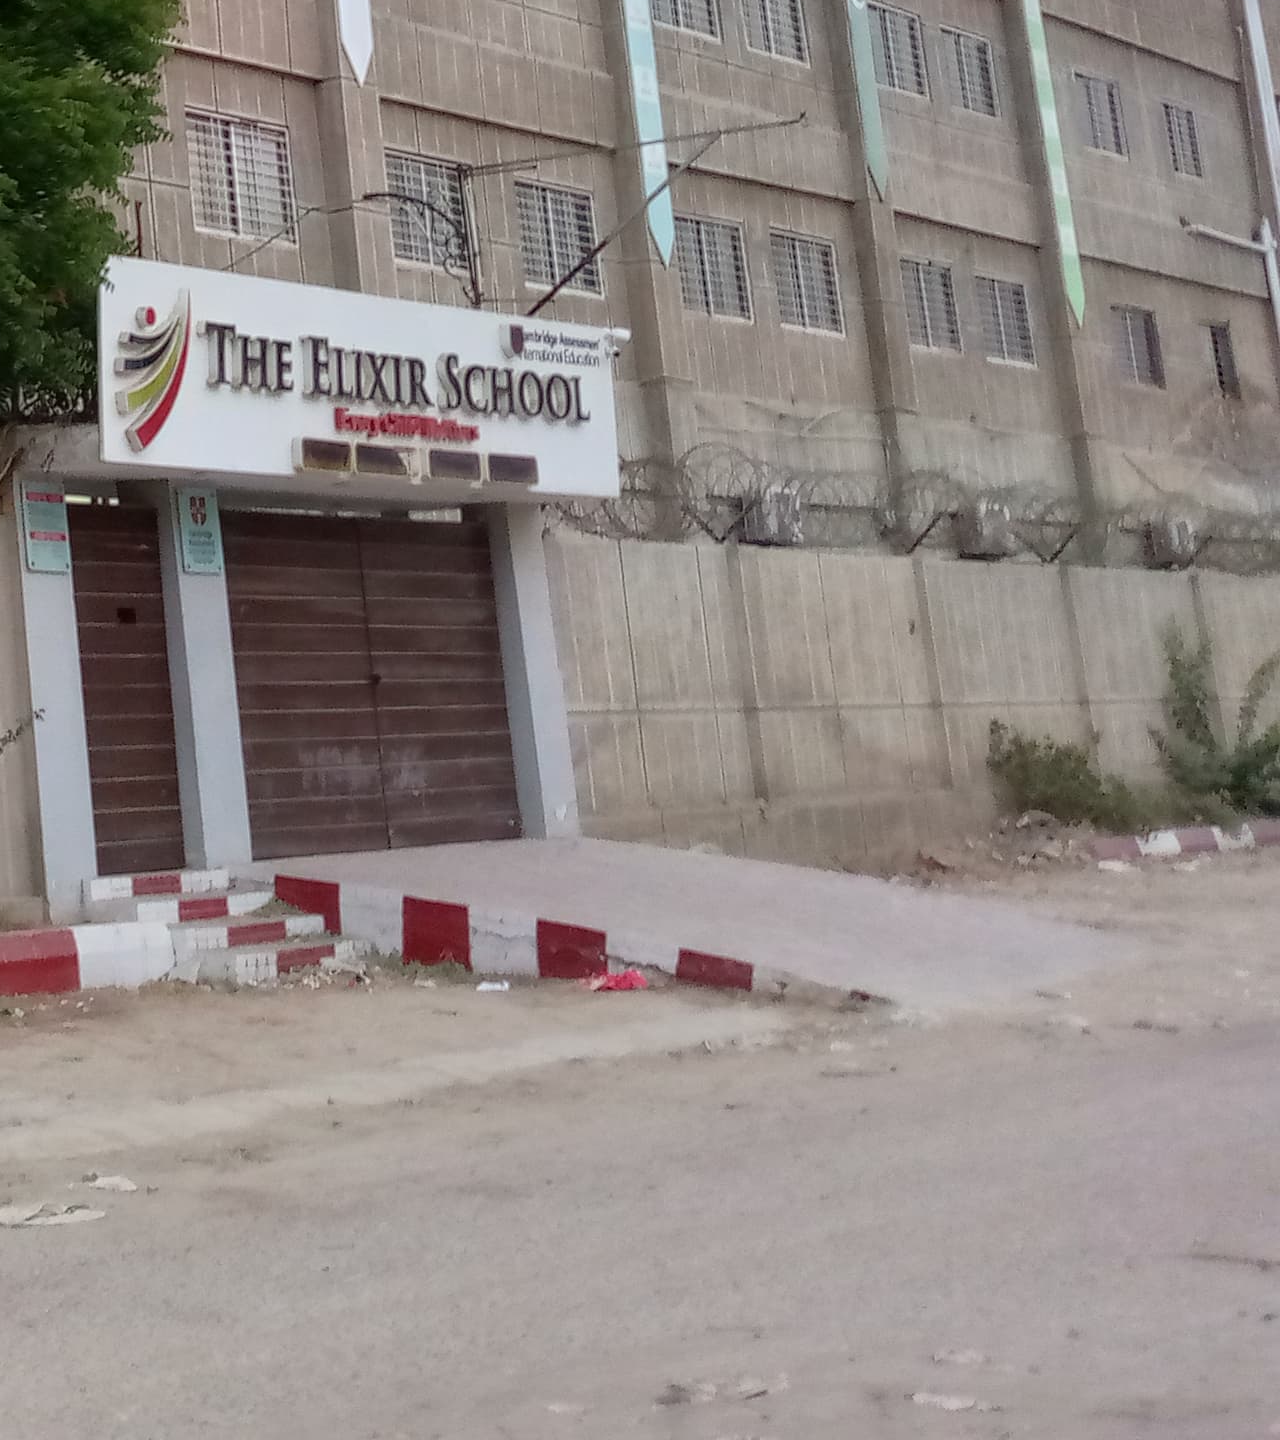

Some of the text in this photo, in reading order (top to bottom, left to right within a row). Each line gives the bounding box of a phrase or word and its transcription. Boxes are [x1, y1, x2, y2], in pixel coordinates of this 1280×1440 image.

[523, 329, 558, 349] ambridge
[202, 321, 591, 423] THE ELIXIR SCHOOL
